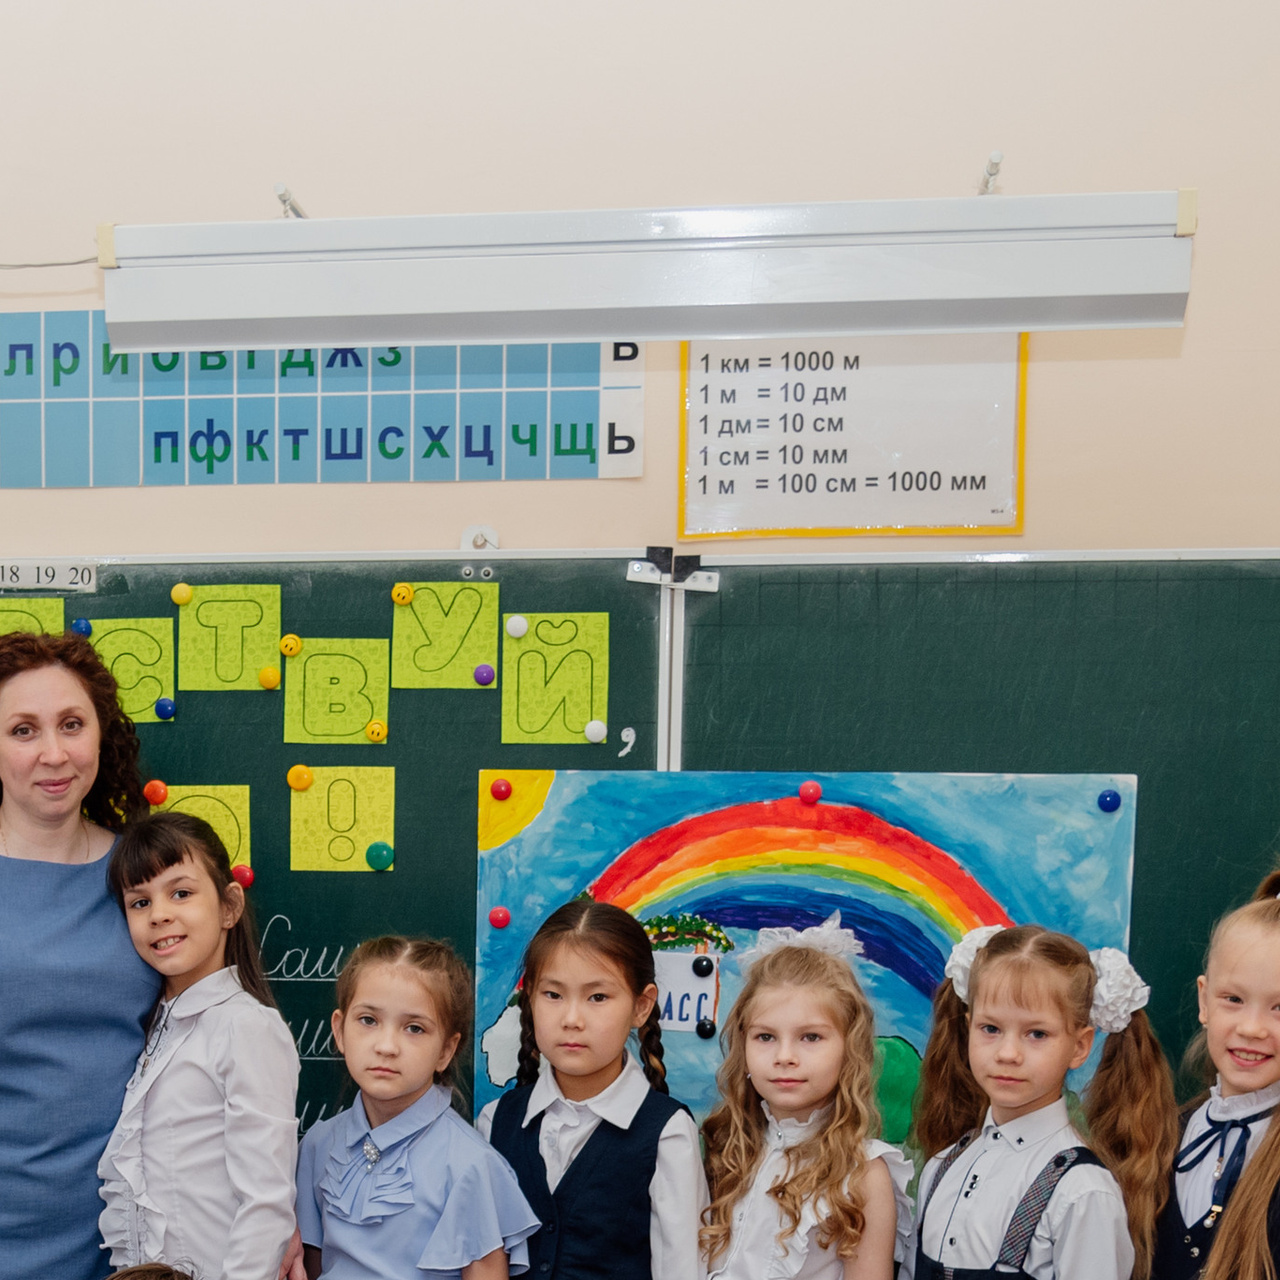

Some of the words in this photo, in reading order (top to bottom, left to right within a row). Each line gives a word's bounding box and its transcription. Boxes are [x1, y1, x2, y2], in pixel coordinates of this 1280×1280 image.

[700, 353, 710, 373] 1
[721, 357, 749, 374] км
[780, 350, 834, 372] 1000
[843, 355, 860, 370] м
[699, 384, 709, 404] 1
[720, 388, 736, 404] м
[779, 382, 805, 402] 10
[812, 385, 847, 405] дм
[699, 414, 709, 435] 1
[718, 417, 751, 437] дм
[778, 413, 805, 433] 10
[812, 416, 844, 432] см
[699, 446, 709, 466] 1
[719, 449, 750, 466] см
[778, 445, 804, 465] 10
[813, 447, 848, 464] мм
[698, 475, 708, 495] 1
[718, 478, 735, 494] м
[777, 473, 817, 493] 100
[825, 477, 857, 493] см
[887, 471, 942, 492] 1000
[950, 474, 986, 491] мм
[0, 565, 20, 583] 18
[35, 566, 56, 585] 19
[69, 567, 92, 586] 20
